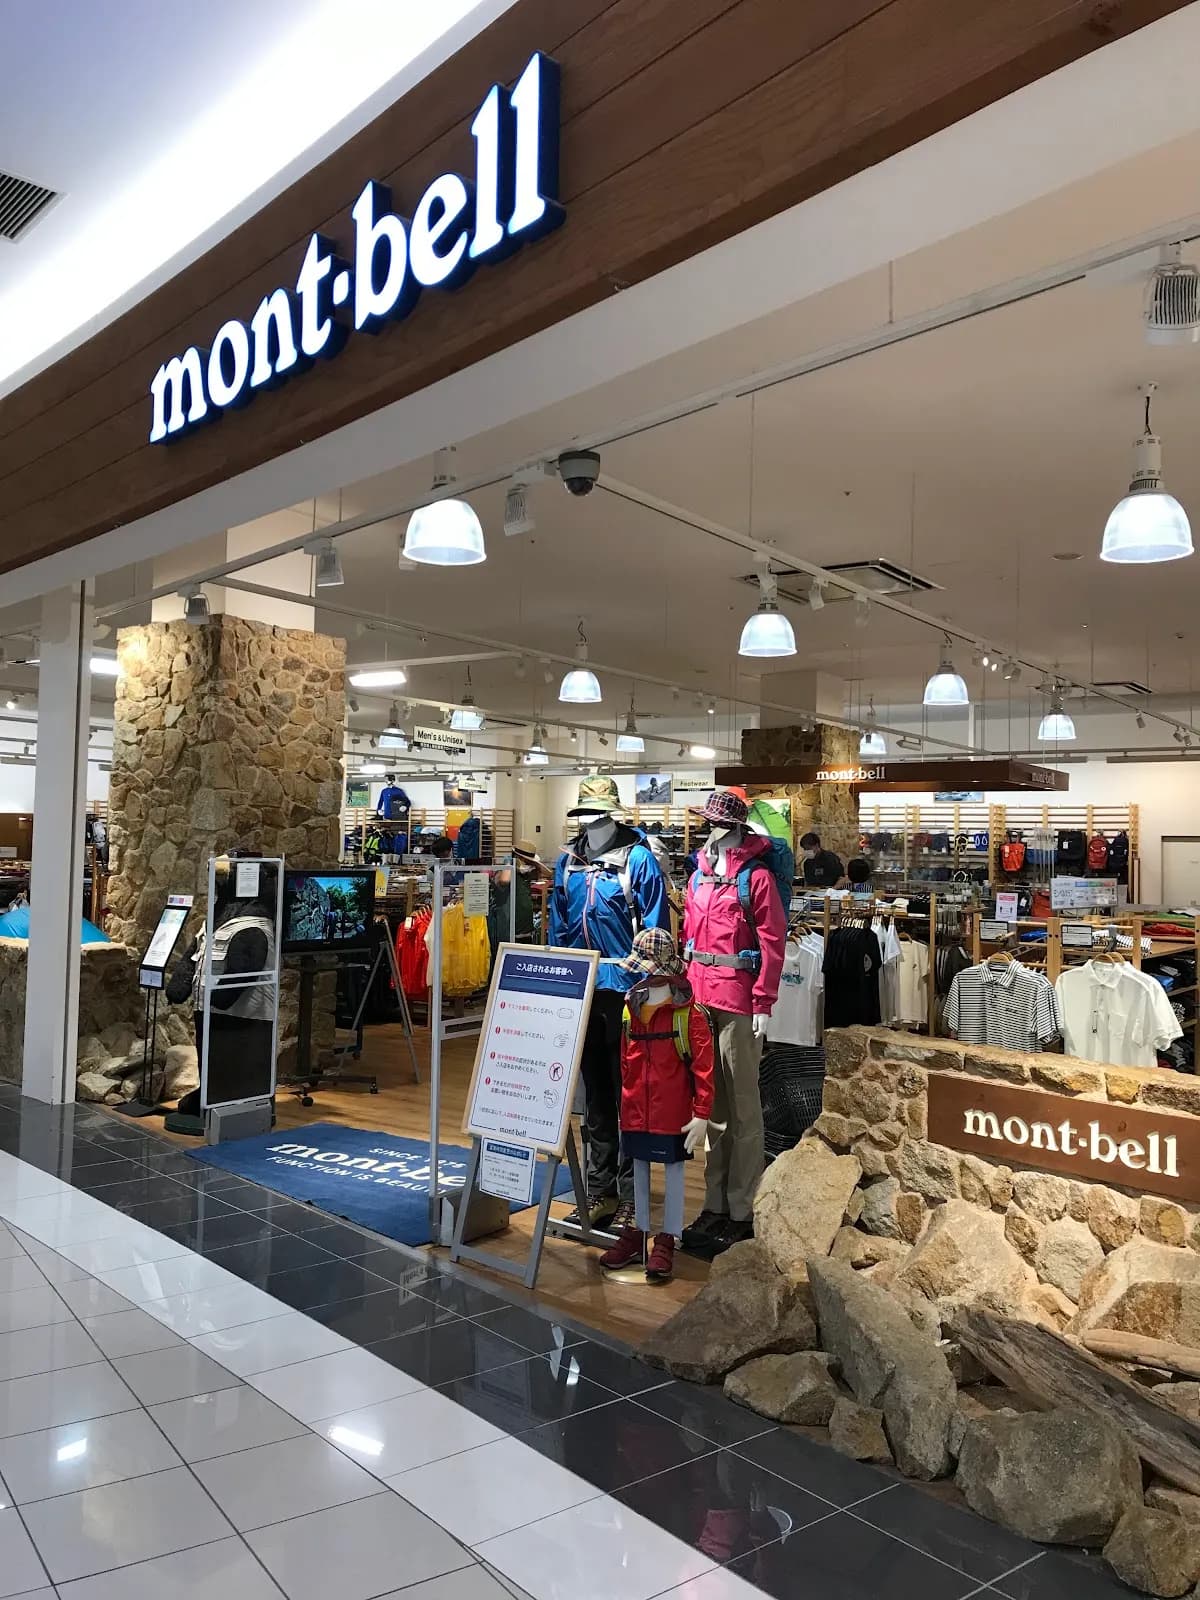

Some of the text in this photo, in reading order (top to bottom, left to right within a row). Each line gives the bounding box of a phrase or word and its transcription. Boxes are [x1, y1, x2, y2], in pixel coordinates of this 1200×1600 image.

[442, 734, 463, 745] Unisex
[369, 1147, 422, 1161] SINCE
[265, 1156, 353, 1177] FUNCTION
[352, 1172, 374, 1181] IS
